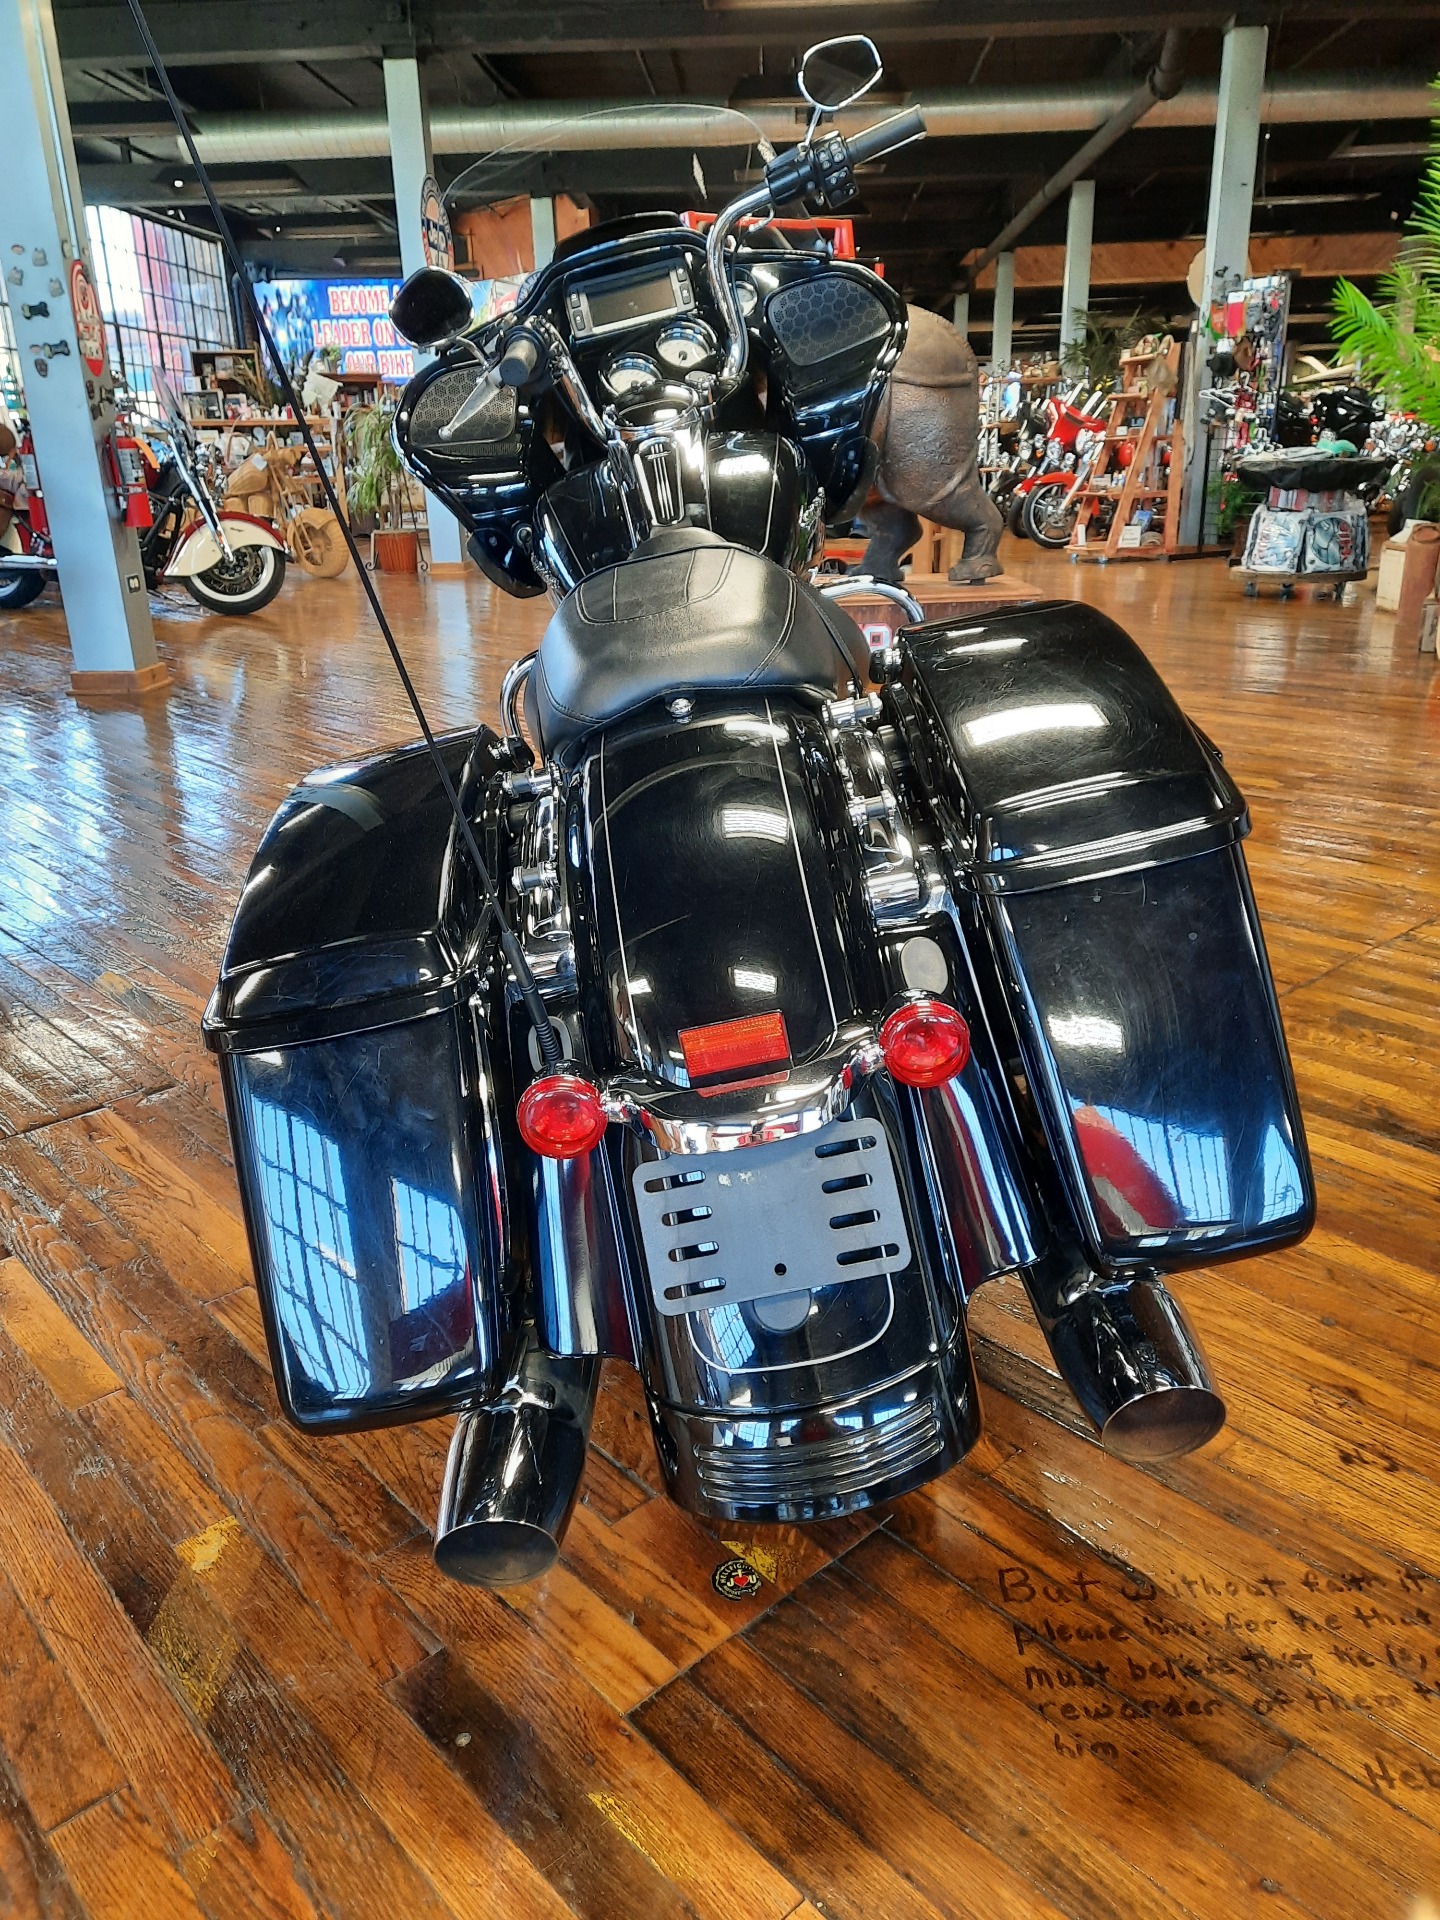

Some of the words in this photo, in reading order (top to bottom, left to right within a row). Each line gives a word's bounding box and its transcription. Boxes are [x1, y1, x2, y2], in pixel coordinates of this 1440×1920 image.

[328, 286, 389, 315] BECOME
[312, 320, 372, 347] LEADER
[373, 319, 395, 347] ON
[998, 1566, 1101, 1603] But
[1120, 1568, 1288, 1601] without
[1301, 1569, 1387, 1593] faith
[1397, 1566, 1427, 1593] it
[1013, 1618, 1131, 1657] please
[1223, 1611, 1278, 1638] for
[1354, 1605, 1432, 1630] that
[1024, 1659, 1110, 1690] must
[1126, 1652, 1238, 1682] believe
[1240, 1647, 1317, 1677] that
[1038, 1695, 1222, 1722] rewarder
[1305, 1687, 1402, 1714] them
